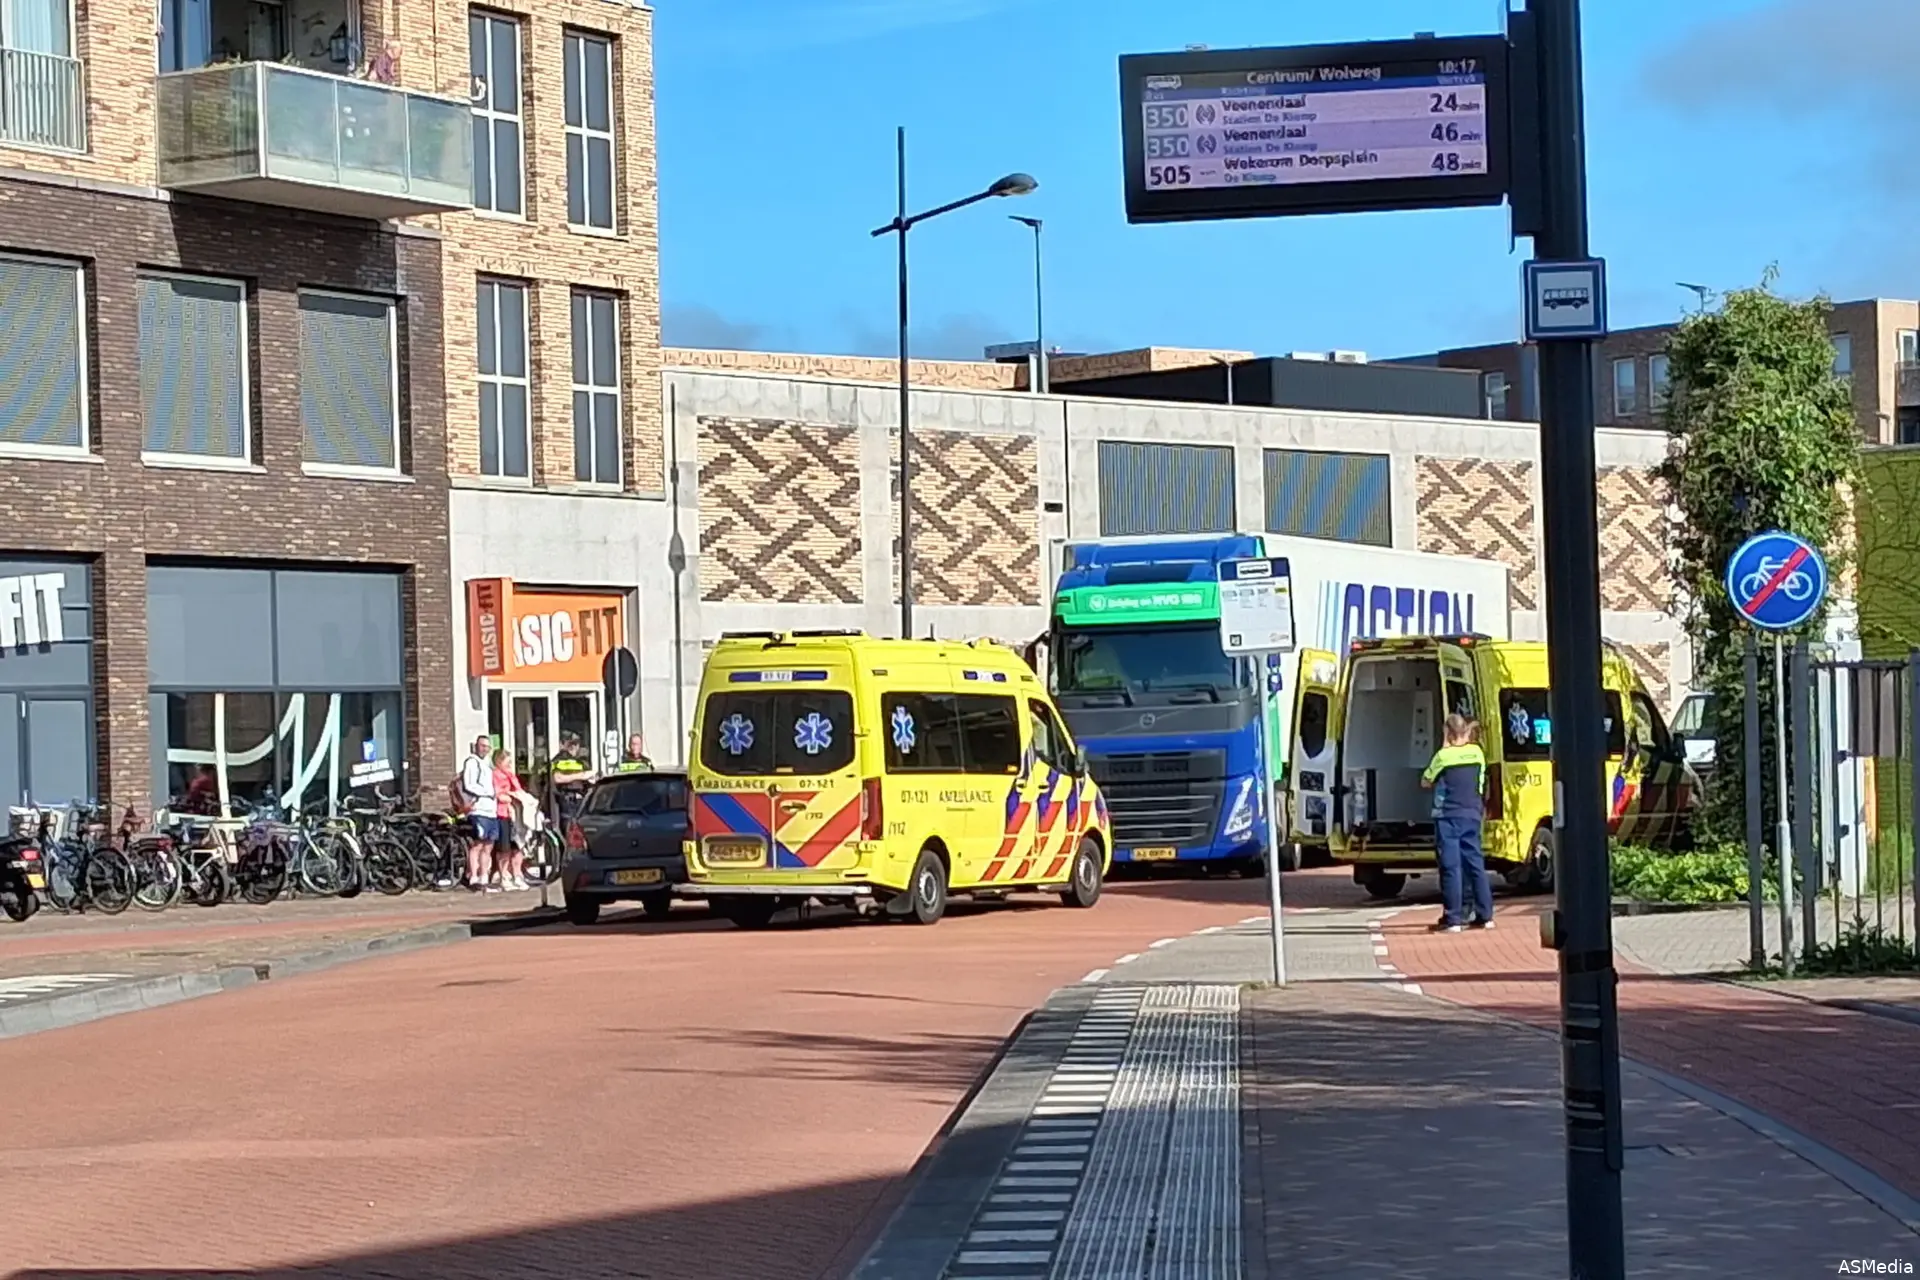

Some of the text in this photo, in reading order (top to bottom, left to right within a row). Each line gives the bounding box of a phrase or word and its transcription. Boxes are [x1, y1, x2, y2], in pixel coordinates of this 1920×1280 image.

[1247, 69, 1314, 84] Centrum/
[1221, 94, 1307, 112] Veenendaal
[1430, 92, 1458, 113] 24
[1147, 106, 1188, 128] 350
[1223, 124, 1307, 141] Veenendaal
[1431, 122, 1459, 142] 46
[1147, 136, 1189, 157] 350
[1223, 150, 1378, 170] Wekerom Dorpsplein
[1431, 152, 1460, 171] 48
[1150, 165, 1191, 186] 505
[696, 777, 835, 789] AMBULANCE 07-121
[901, 790, 994, 803] 07-121 AMBULANCE
